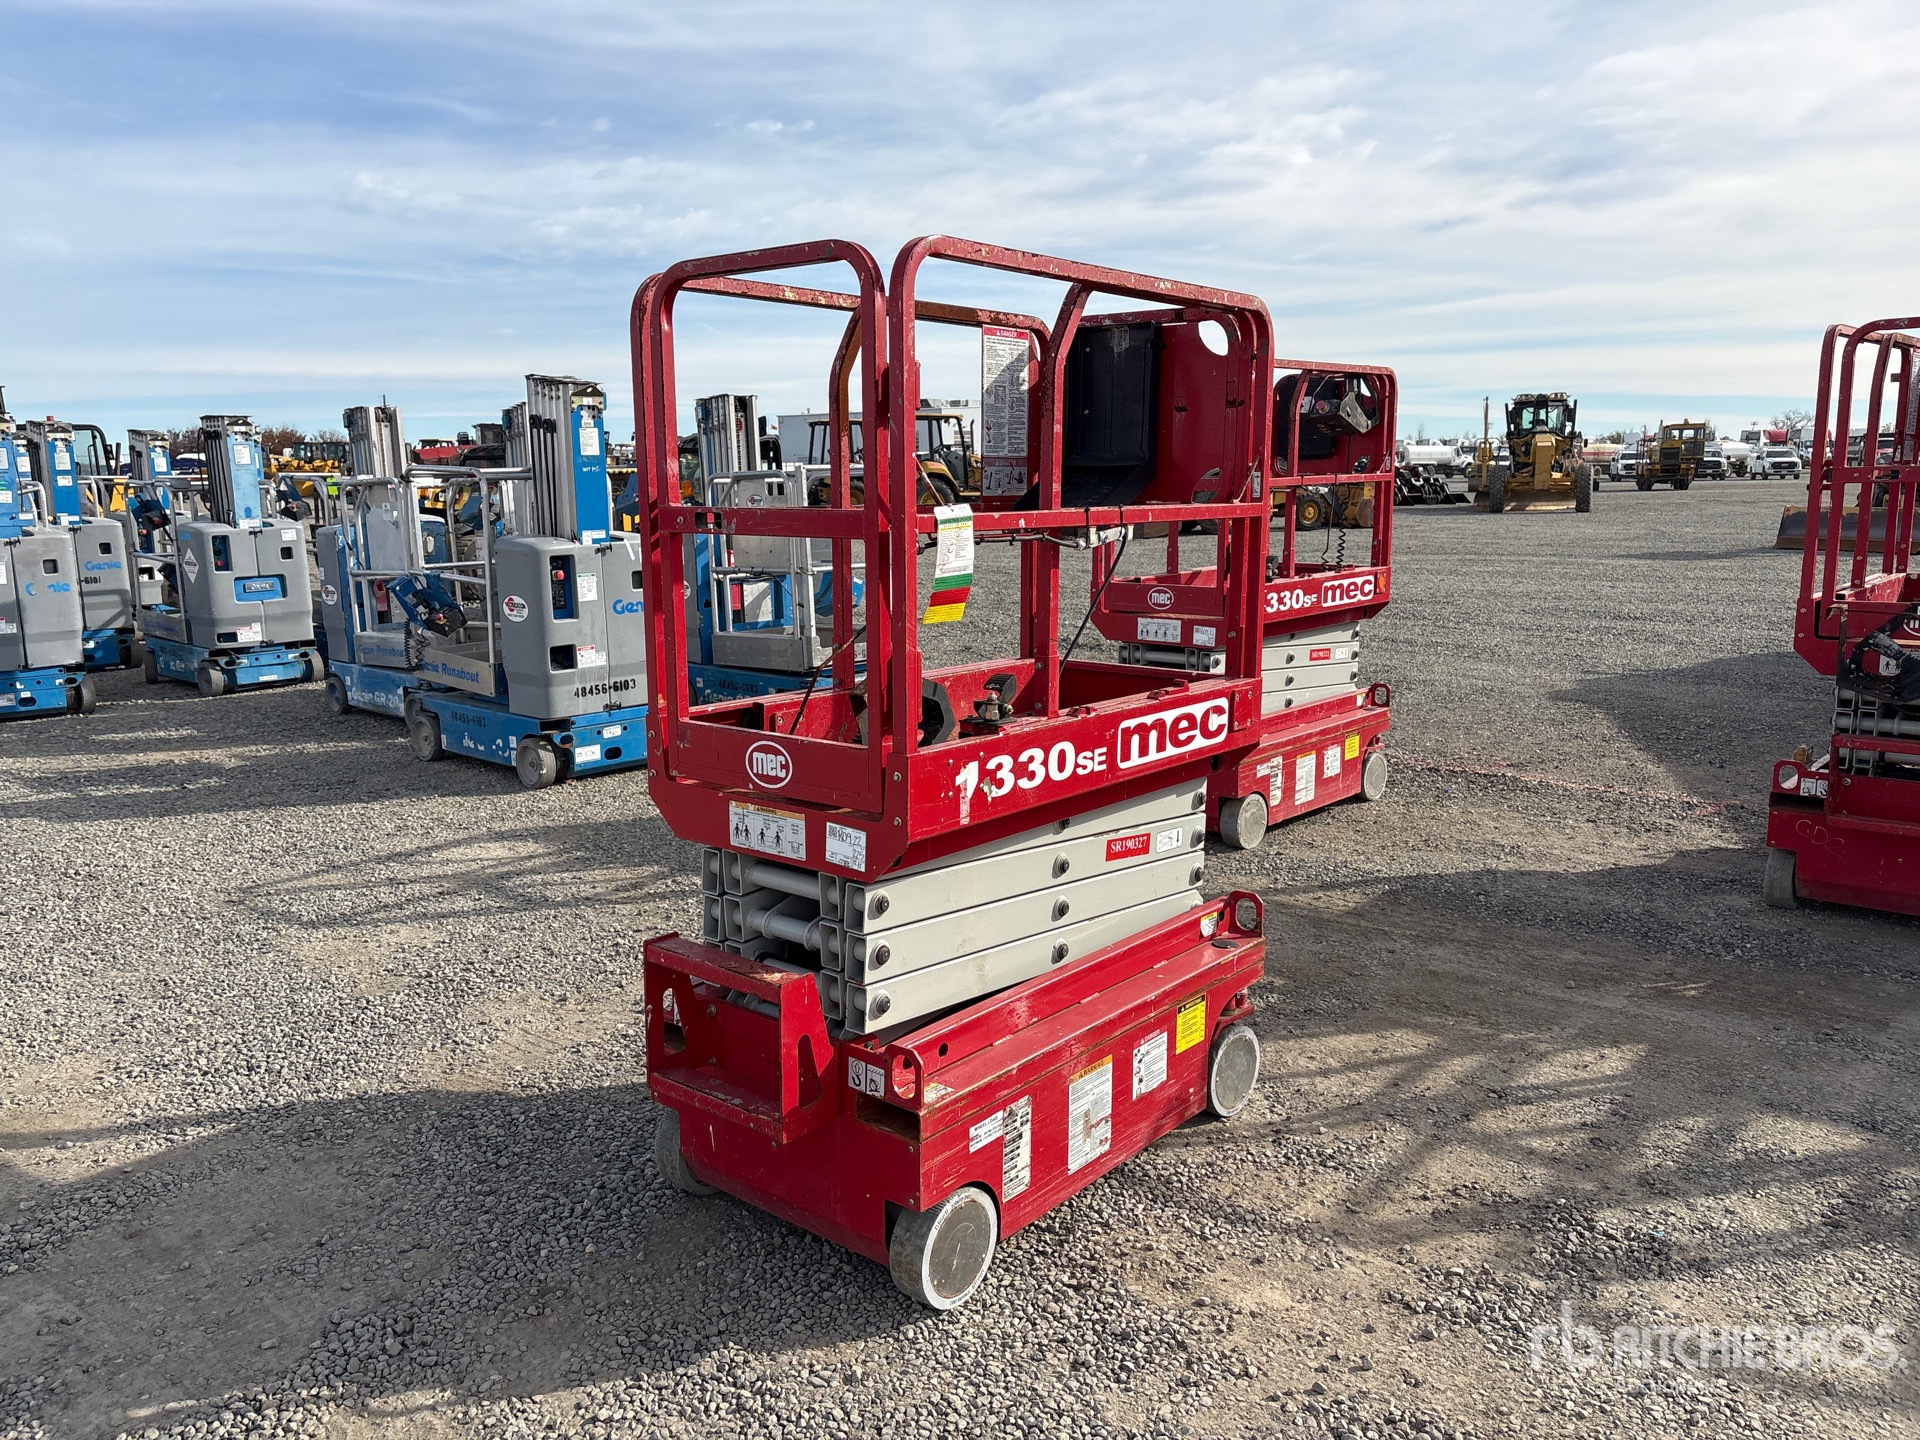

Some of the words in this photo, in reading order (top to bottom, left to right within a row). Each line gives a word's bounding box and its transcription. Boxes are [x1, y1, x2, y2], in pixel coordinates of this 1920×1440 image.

[84, 559, 123, 571] Genie
[1151, 592, 1171, 605] mec
[1264, 587, 1318, 613] 330SE
[1322, 578, 1373, 605] mec
[441, 662, 480, 684] Runabout
[573, 678, 637, 699] 48456-6103
[1119, 703, 1227, 763] mec
[752, 751, 787, 779] mec
[1110, 836, 1148, 854] SR190327
[1144, 1028, 1161, 1042] DANGER
[974, 1121, 988, 1132] WHEEL
[987, 1115, 999, 1125] LOAD
